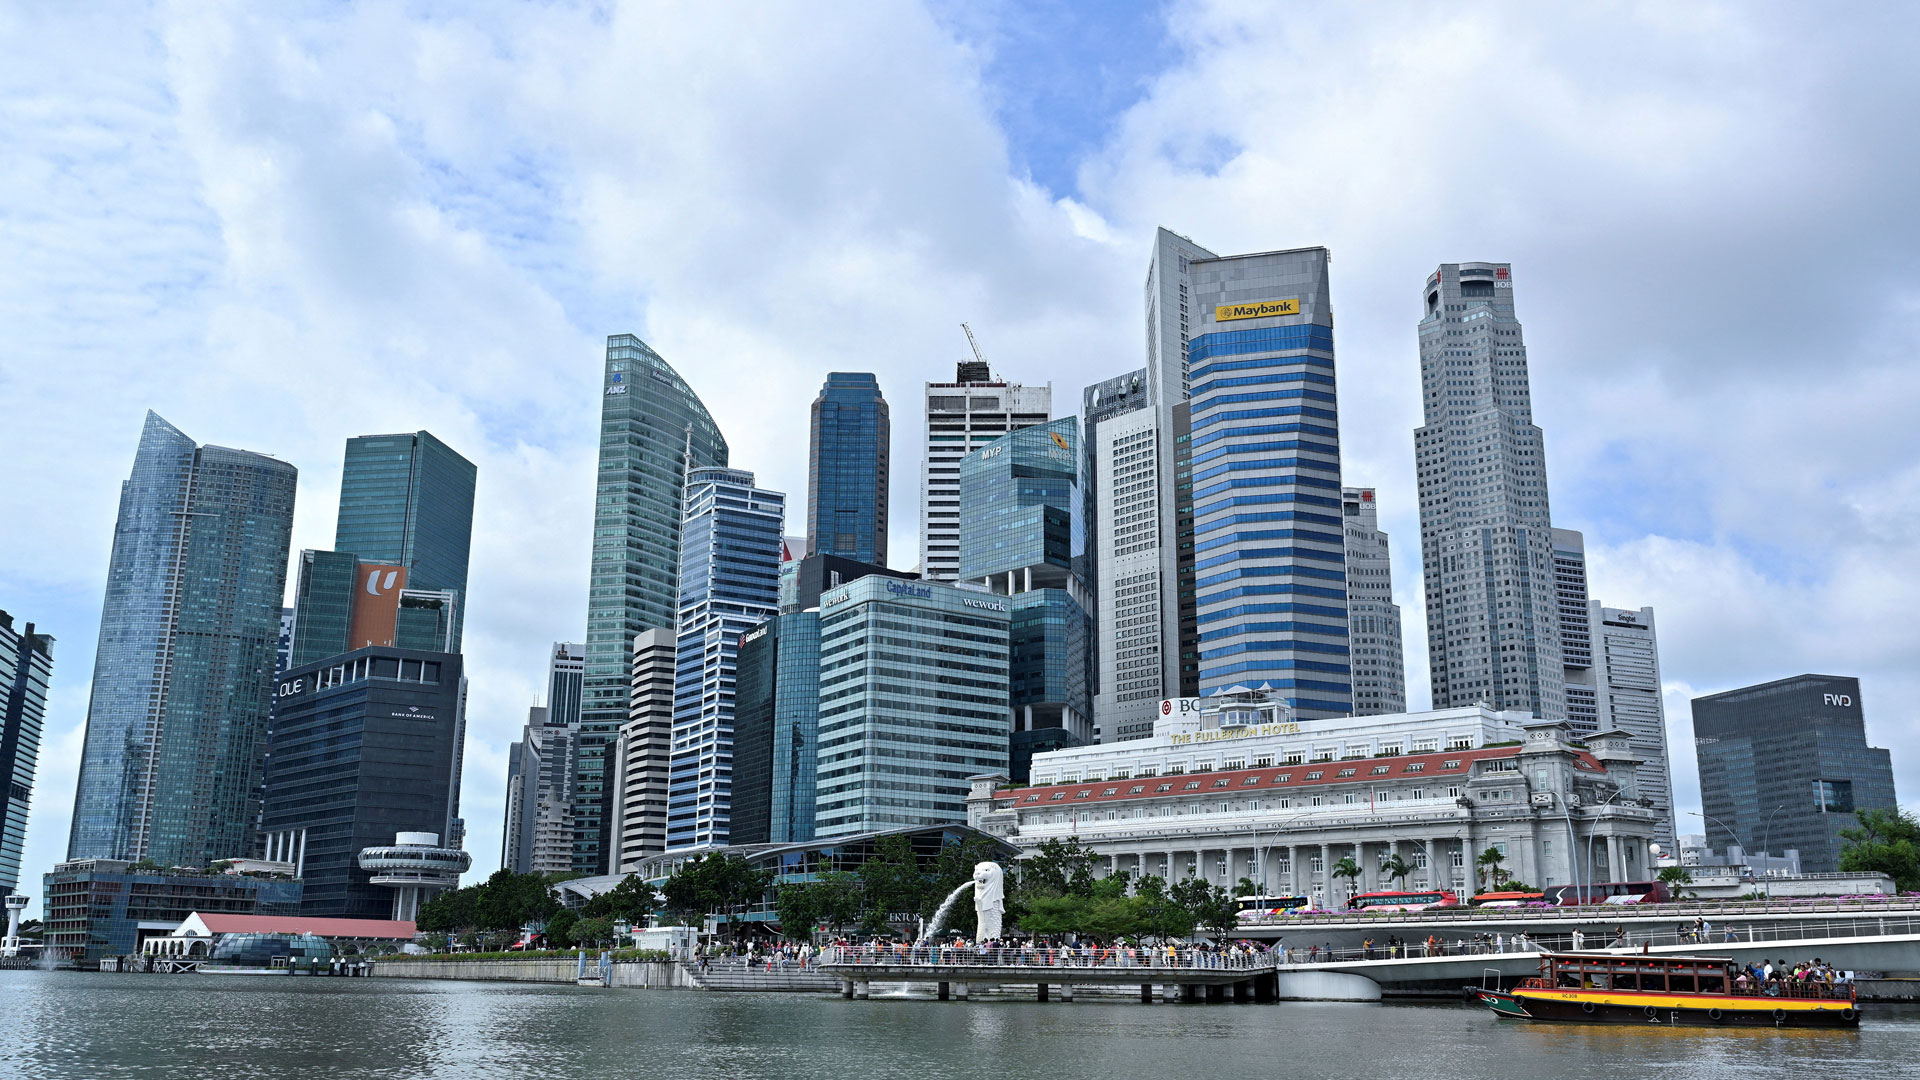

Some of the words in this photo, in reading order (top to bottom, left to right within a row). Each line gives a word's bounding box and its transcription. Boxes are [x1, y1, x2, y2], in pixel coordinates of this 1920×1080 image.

[1494, 281, 1513, 289] UOB
[1234, 302, 1291, 316] Maybank
[606, 385, 627, 395] ANZ
[982, 446, 1002, 460] MYP
[887, 580, 931, 599] CapitaLand
[963, 598, 1006, 612] wework
[1618, 613, 1636, 624] Singtel
[279, 679, 303, 697] OUE
[1823, 693, 1851, 707] FWD
[1171, 733, 1192, 744] THE
[1195, 727, 1258, 743] FULLERTON
[1261, 722, 1301, 735] HOTEL
